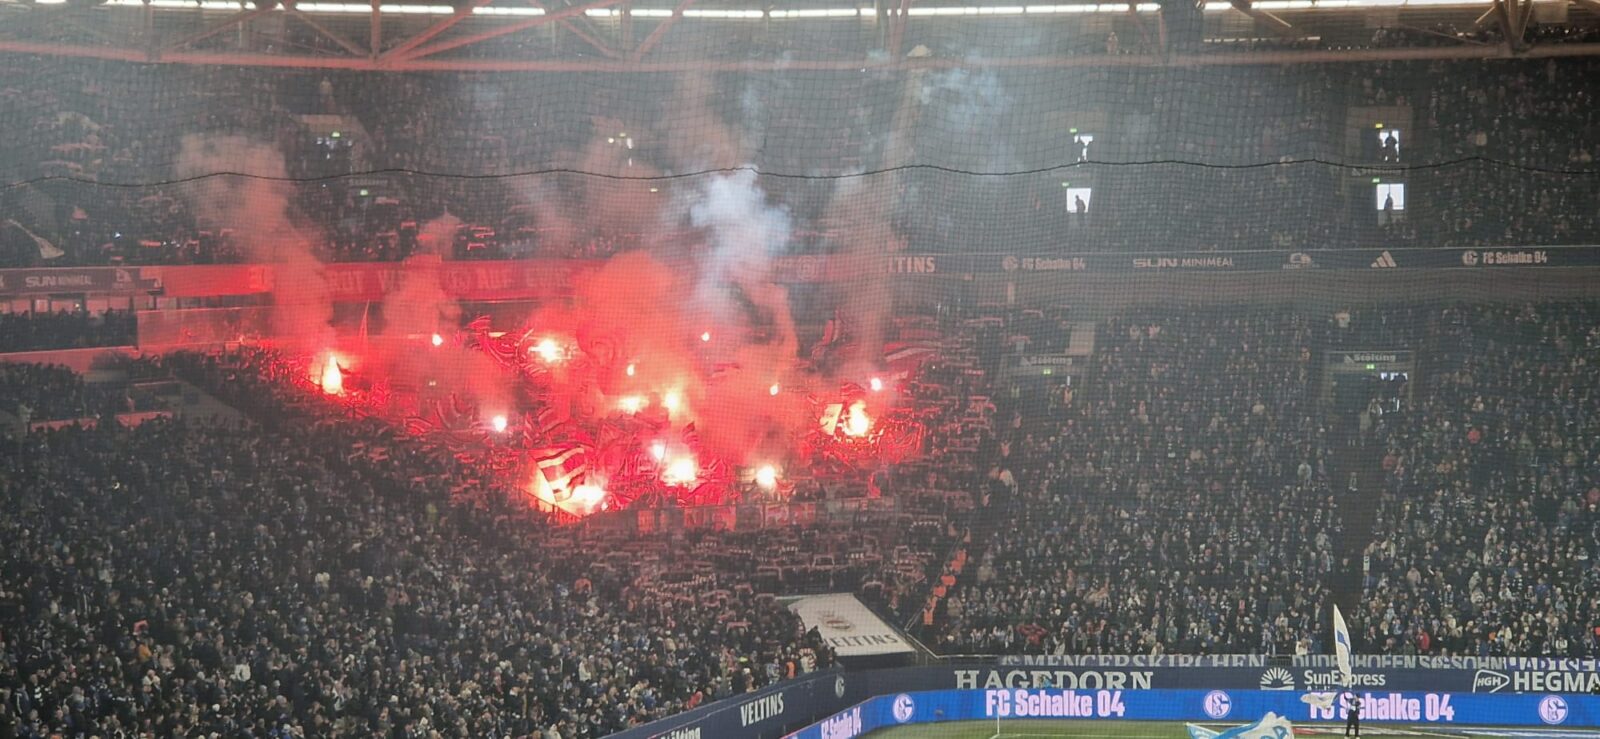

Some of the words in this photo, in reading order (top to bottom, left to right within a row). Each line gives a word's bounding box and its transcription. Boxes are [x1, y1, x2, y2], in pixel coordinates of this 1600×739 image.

[886, 256, 936, 273] LTINS
[1133, 258, 1178, 268] SUN
[1180, 257, 1234, 267] MINIMEAL
[1483, 252, 1495, 264] FC
[1495, 252, 1533, 264] Schalke
[1534, 251, 1548, 264] 04
[25, 276, 57, 287] SUN
[954, 669, 1154, 690] HAGEDORN
[1303, 669, 1386, 688] SunEpress
[1477, 676, 1502, 687] HGH
[740, 692, 784, 728] VELTINS
[986, 689, 1011, 717] FC
[1015, 690, 1092, 717] Schalke
[1097, 690, 1125, 717] 04
[1425, 693, 1454, 721] 04
